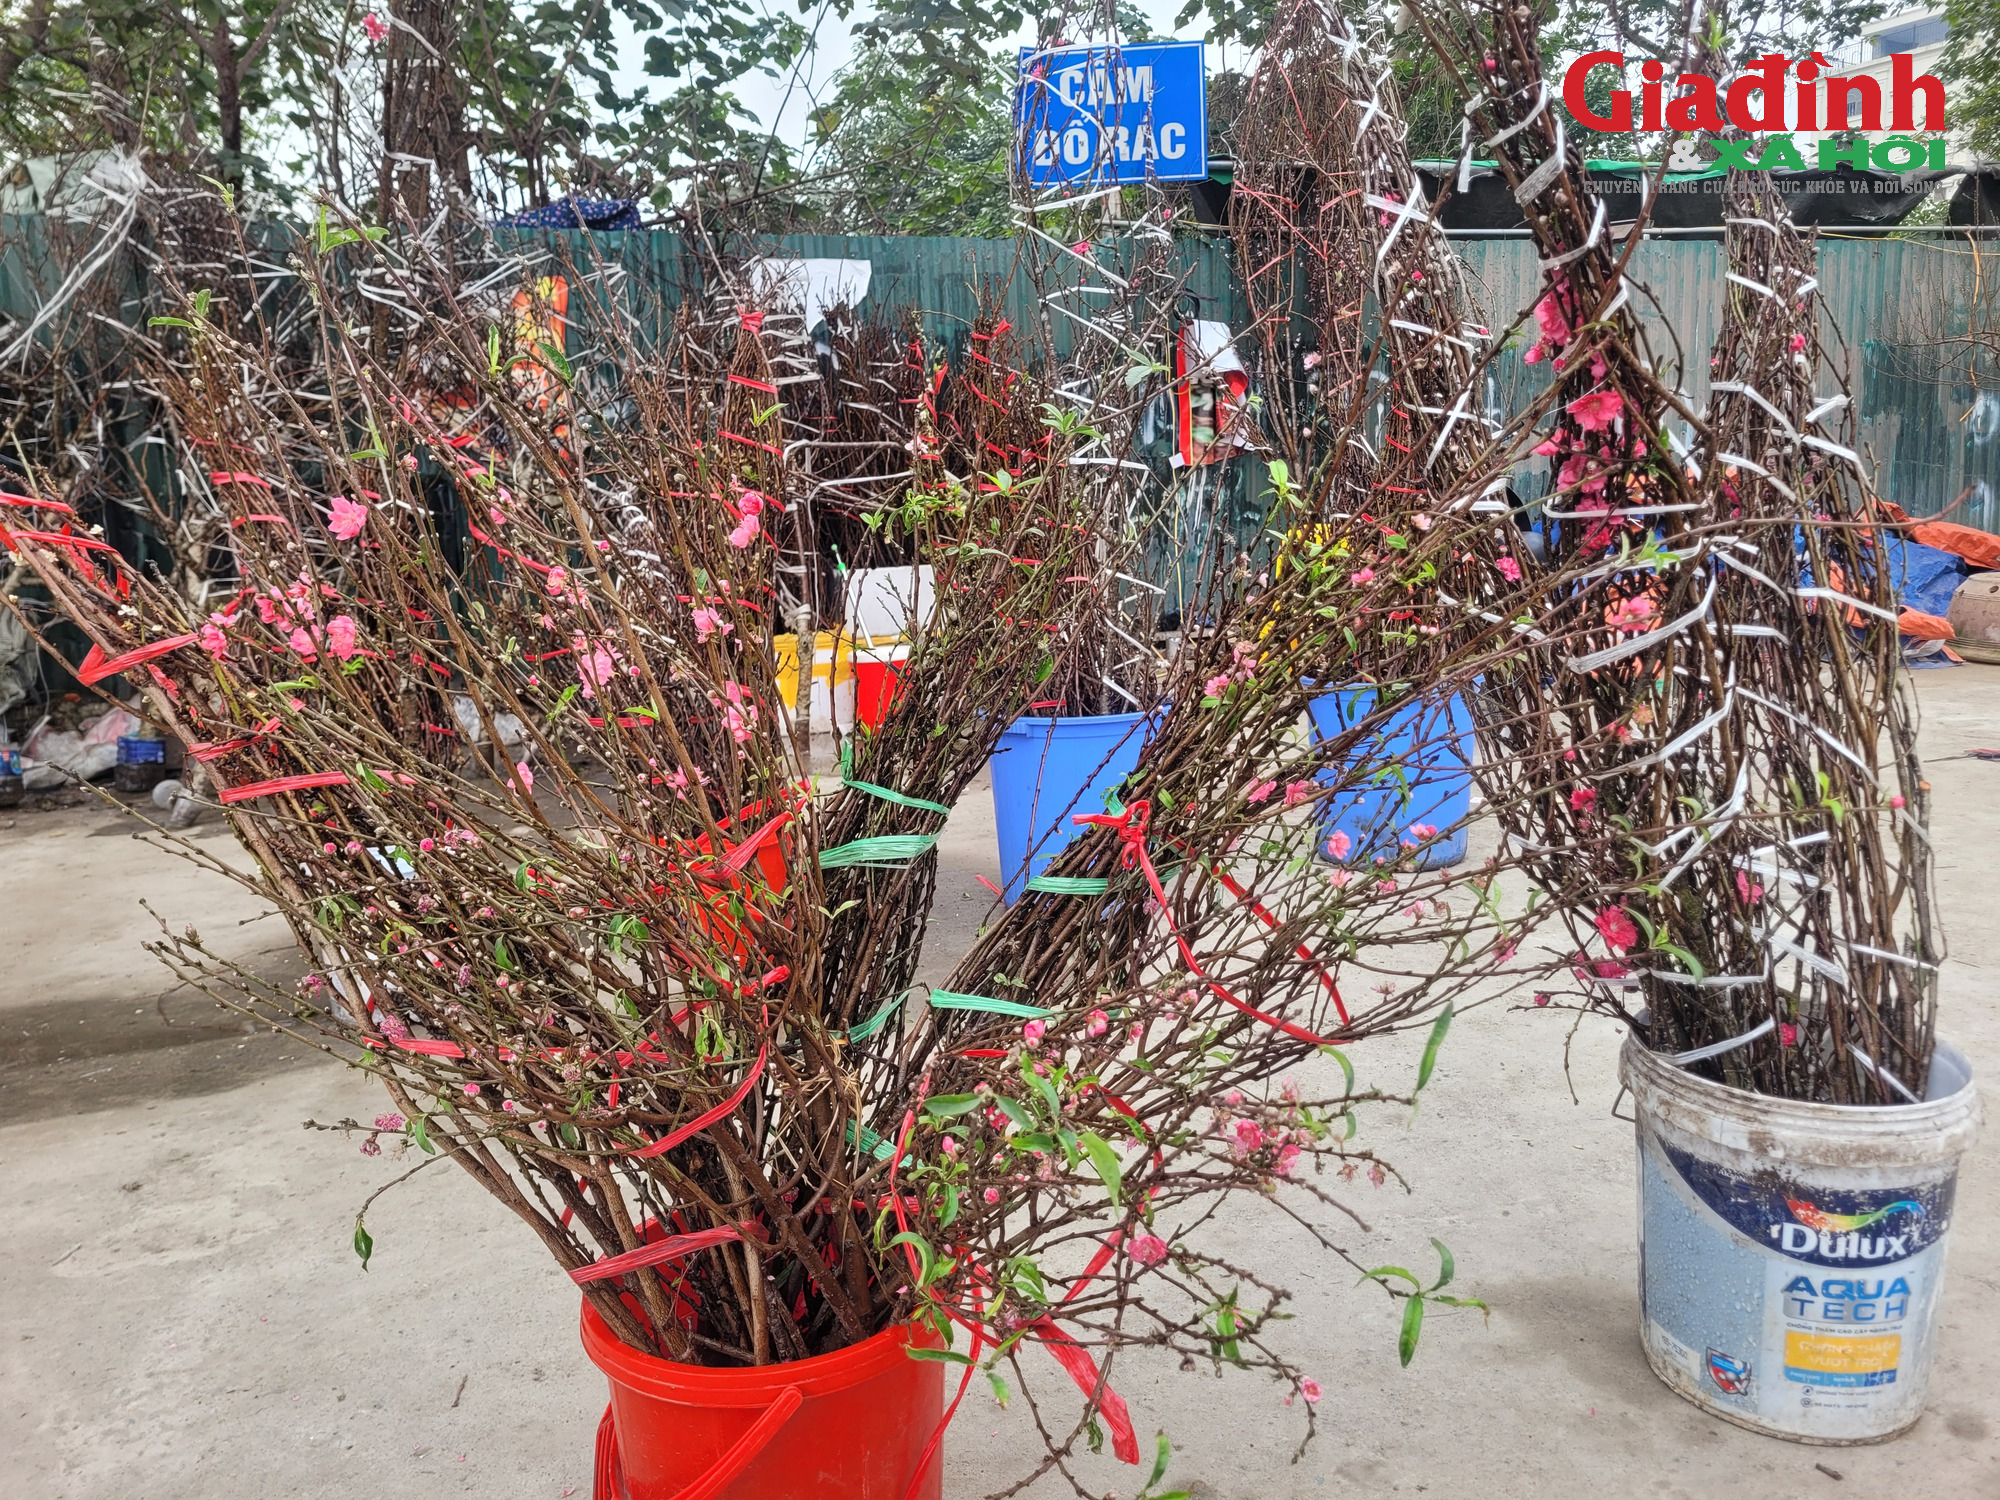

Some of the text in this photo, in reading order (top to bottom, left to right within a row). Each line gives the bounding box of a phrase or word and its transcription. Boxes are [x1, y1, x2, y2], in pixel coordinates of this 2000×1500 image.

[1781, 1222, 1908, 1259] Dulux
[1781, 1275, 1911, 1301] AQUA
[1790, 1298, 1906, 1321] TECH
